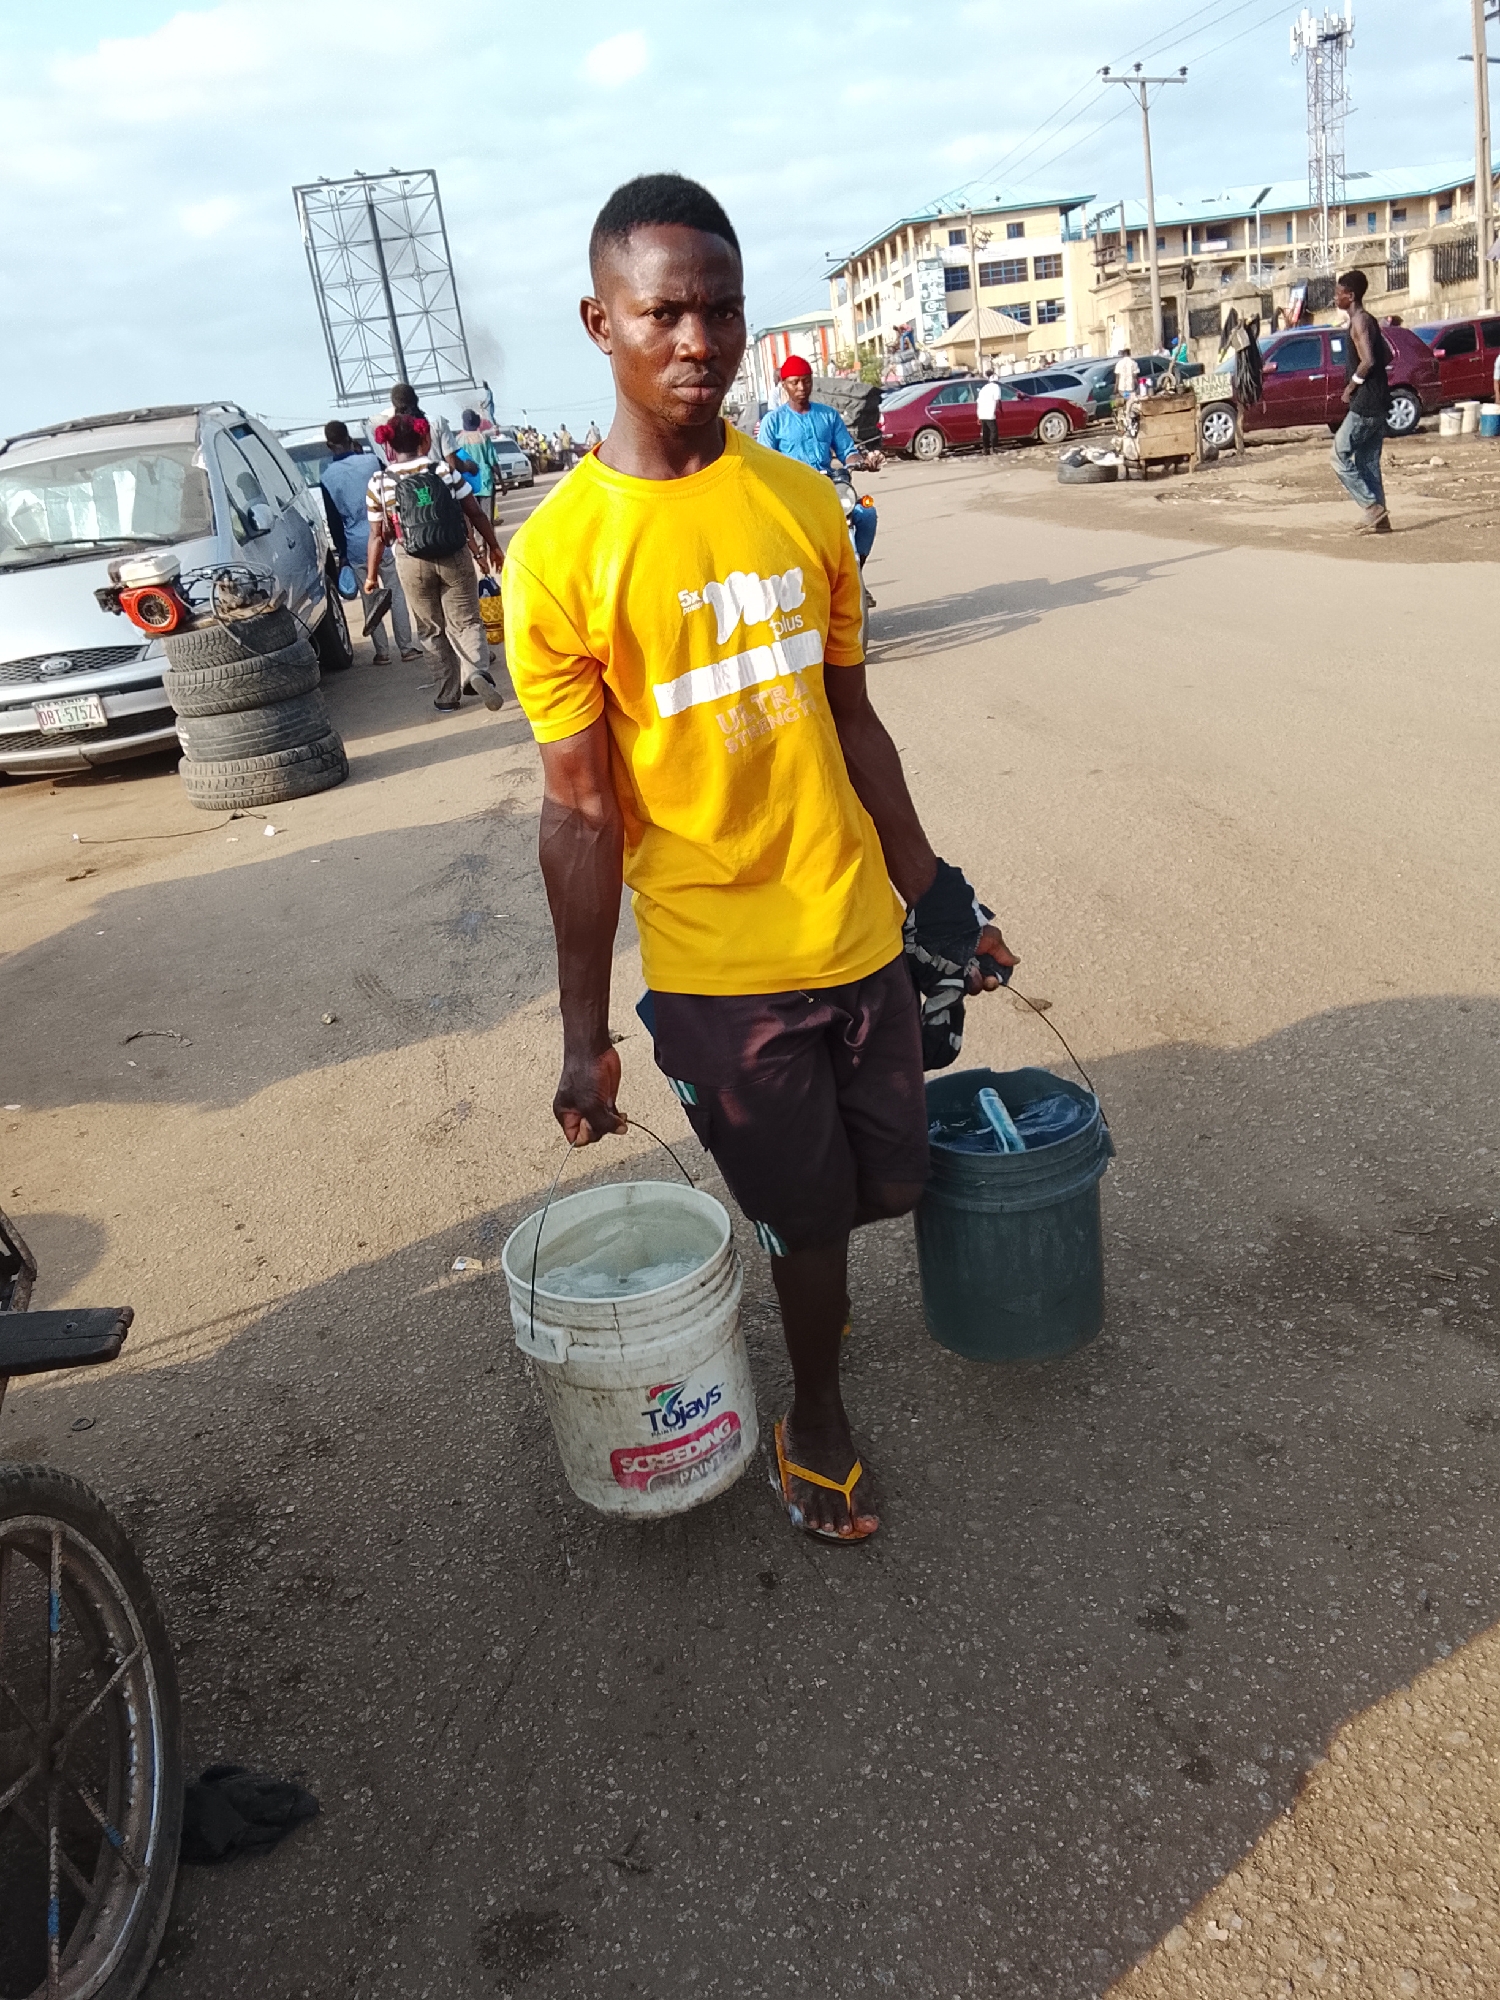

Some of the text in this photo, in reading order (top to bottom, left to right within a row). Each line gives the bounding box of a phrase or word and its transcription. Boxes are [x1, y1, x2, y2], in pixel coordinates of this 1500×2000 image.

[769, 613, 804, 641] plus
[716, 675, 808, 735] ULTRA
[641, 1385, 722, 1432] Tojays
[620, 1418, 732, 1474] SCREEDING
[679, 1454, 723, 1485] PAINT
